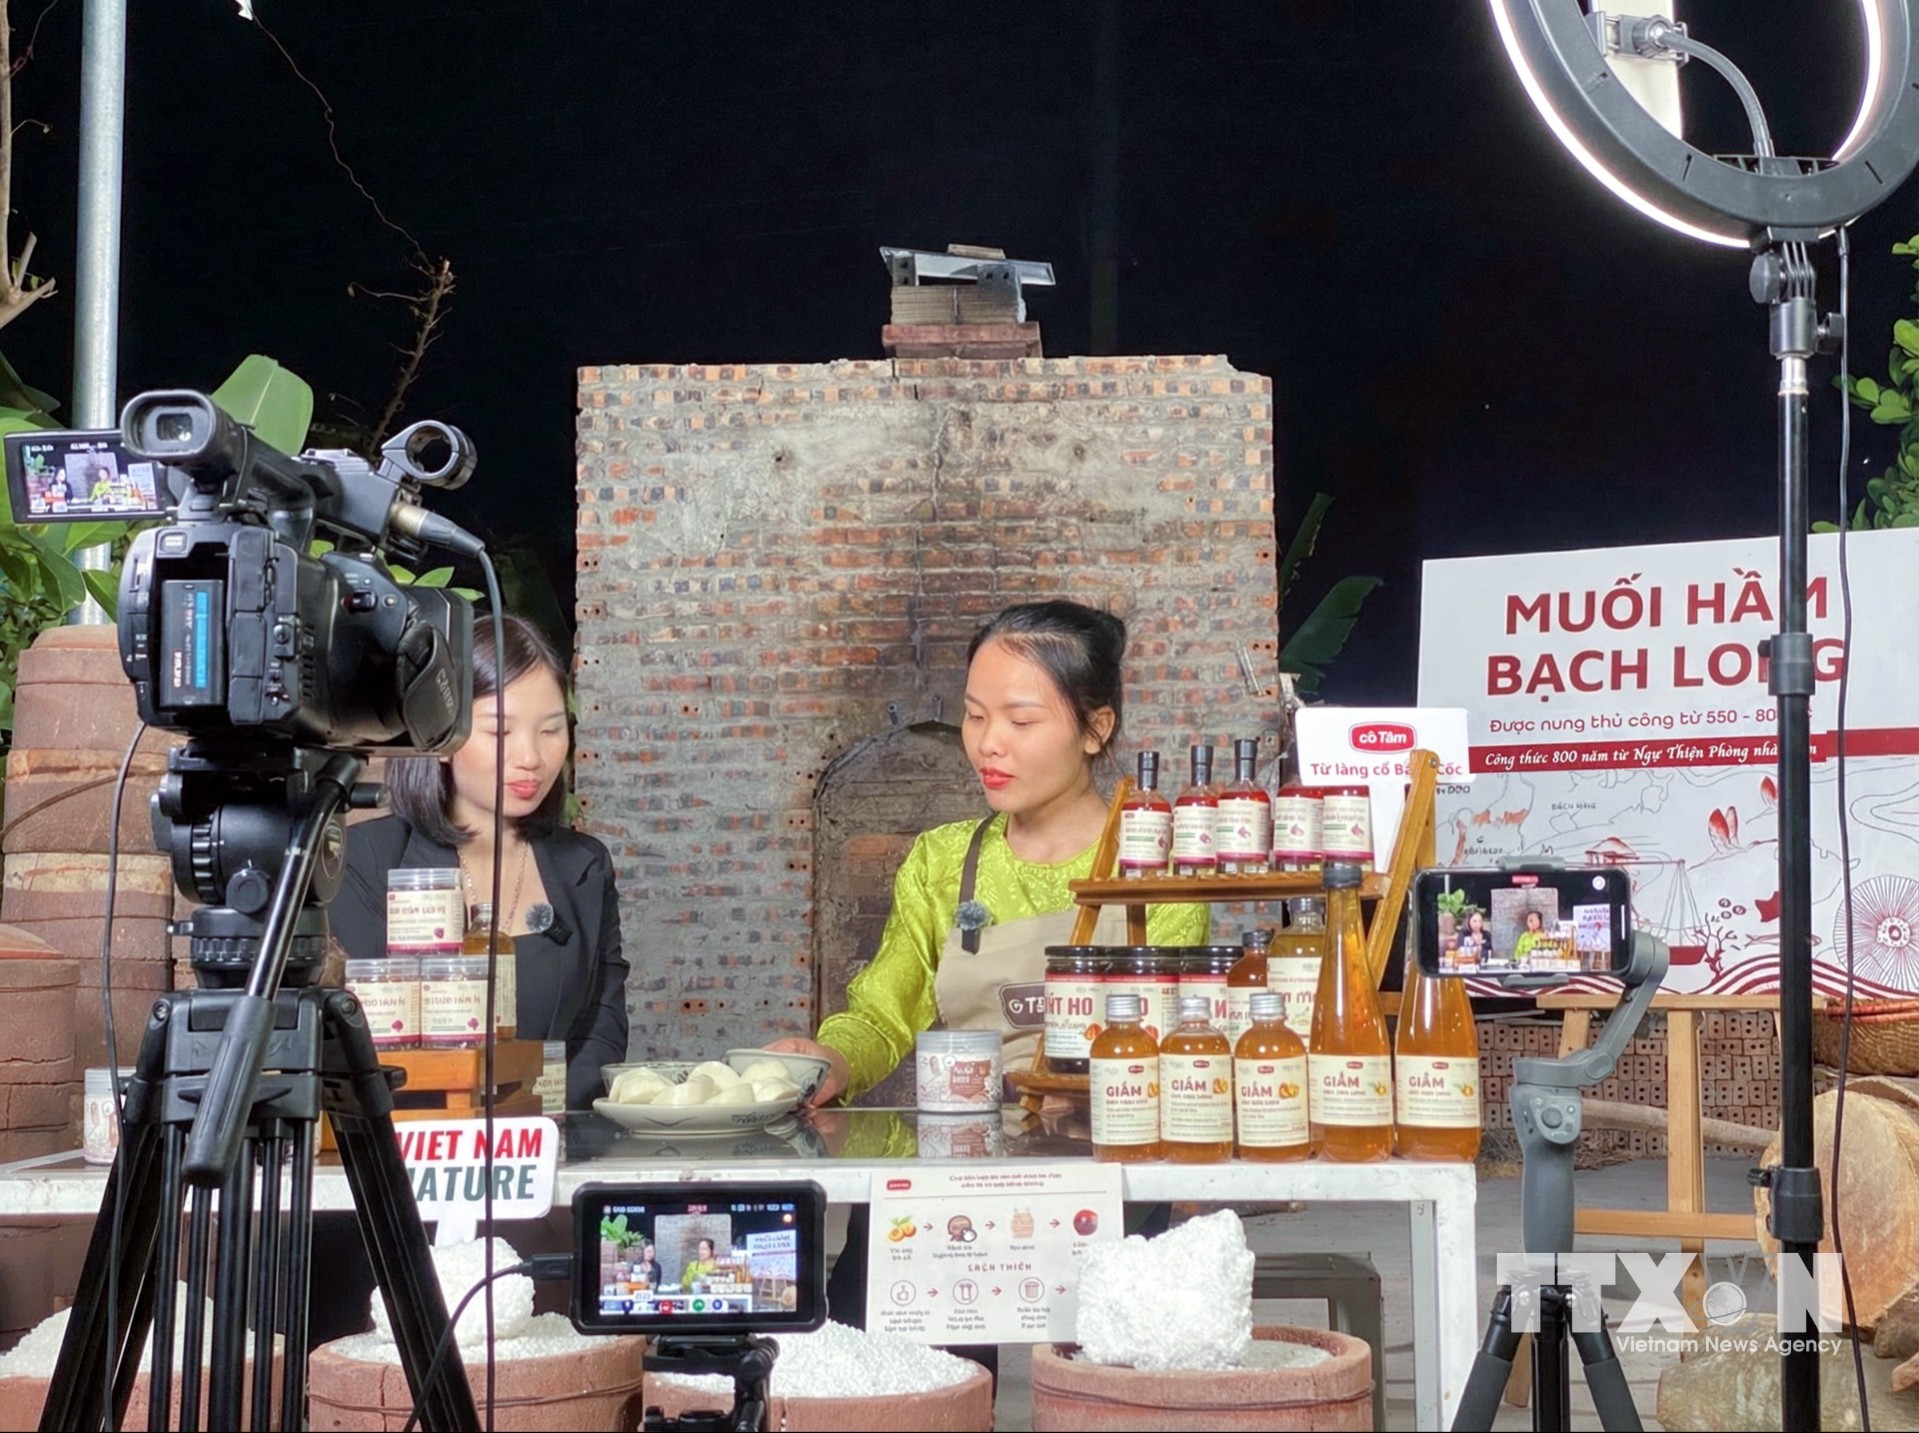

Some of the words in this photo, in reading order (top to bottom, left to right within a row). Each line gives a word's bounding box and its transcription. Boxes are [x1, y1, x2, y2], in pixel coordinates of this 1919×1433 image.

[1505, 572, 1662, 635] MUỐI
[1487, 648, 1649, 703] BẠCH
[1673, 638, 1844, 690] LOG
[1358, 730, 1377, 744] cô
[1378, 730, 1408, 744] Tâm
[1489, 719, 1535, 735] Được
[1541, 719, 1585, 733] nung
[1591, 713, 1622, 729] thủ
[1628, 712, 1674, 730] công
[1680, 710, 1702, 725] từ
[1706, 710, 1737, 724] 550
[1310, 762, 1331, 776] Từ
[1336, 761, 1369, 779] làng
[1485, 752, 1516, 770] Công
[1519, 749, 1549, 765] thức
[1552, 750, 1578, 764] 800
[1581, 748, 1608, 763] năm
[1612, 748, 1630, 761] từ
[1632, 744, 1663, 766] Ngự
[1667, 743, 1704, 762] Thiện
[1708, 744, 1749, 763] Phòng
[1753, 741, 1778, 756] nhà
[395, 1130, 463, 1161] VIET
[473, 1127, 543, 1160] NAM
[407, 1164, 537, 1202] ATURE
